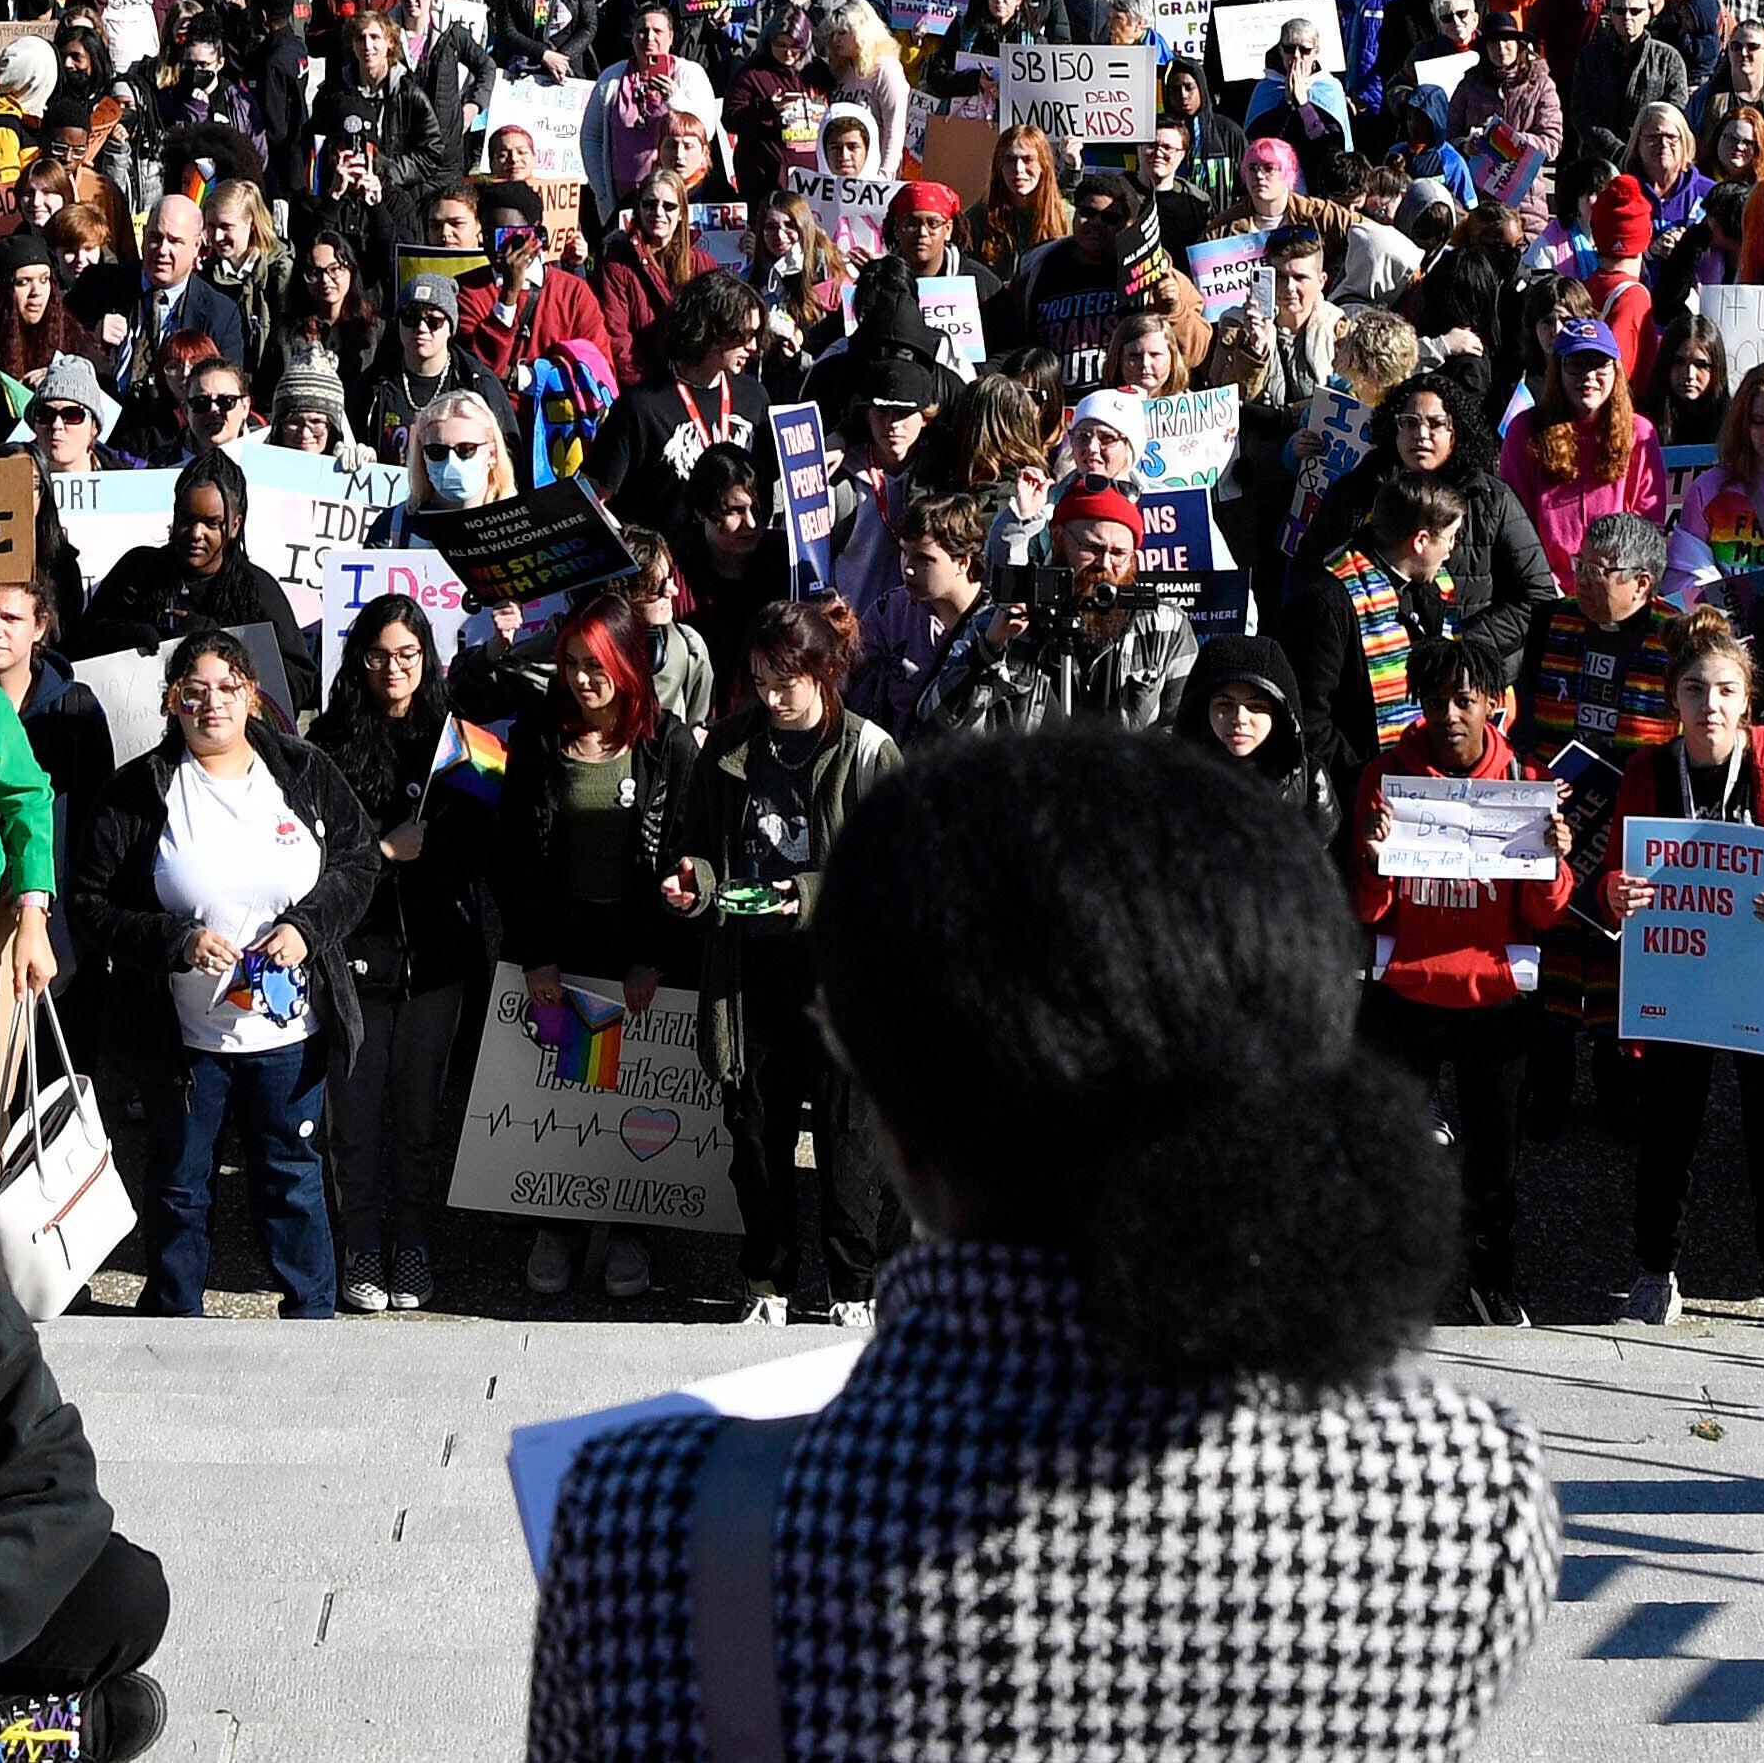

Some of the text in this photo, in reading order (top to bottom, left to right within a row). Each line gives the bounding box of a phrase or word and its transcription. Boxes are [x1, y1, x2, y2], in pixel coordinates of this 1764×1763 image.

[685, 0, 719, 12] WITH
[894, 2, 962, 19] TRANS KIDS
[1085, 89, 1131, 104] DEAD
[1010, 99, 1135, 137] MORE KIDS
[793, 172, 892, 207] WE SAY
[1142, 386, 1232, 441] TRANS
[778, 422, 814, 456] TRANS
[344, 469, 399, 507] MY
[789, 463, 825, 500] PEOPLE
[464, 504, 530, 531] NO SHAME
[477, 518, 531, 542] NO FEAR
[447, 512, 588, 559] ALL ARE WELCOME HERE
[469, 536, 589, 583] WE STAND
[536, 550, 611, 586] PRIDE
[1209, 608, 1238, 621] HERE
[1386, 781, 1426, 803] They
[1416, 809, 1447, 838] Be
[1643, 838, 1764, 878] PROTECT
[1645, 882, 1736, 917] TRANS
[1641, 927, 1708, 959] KIDS
